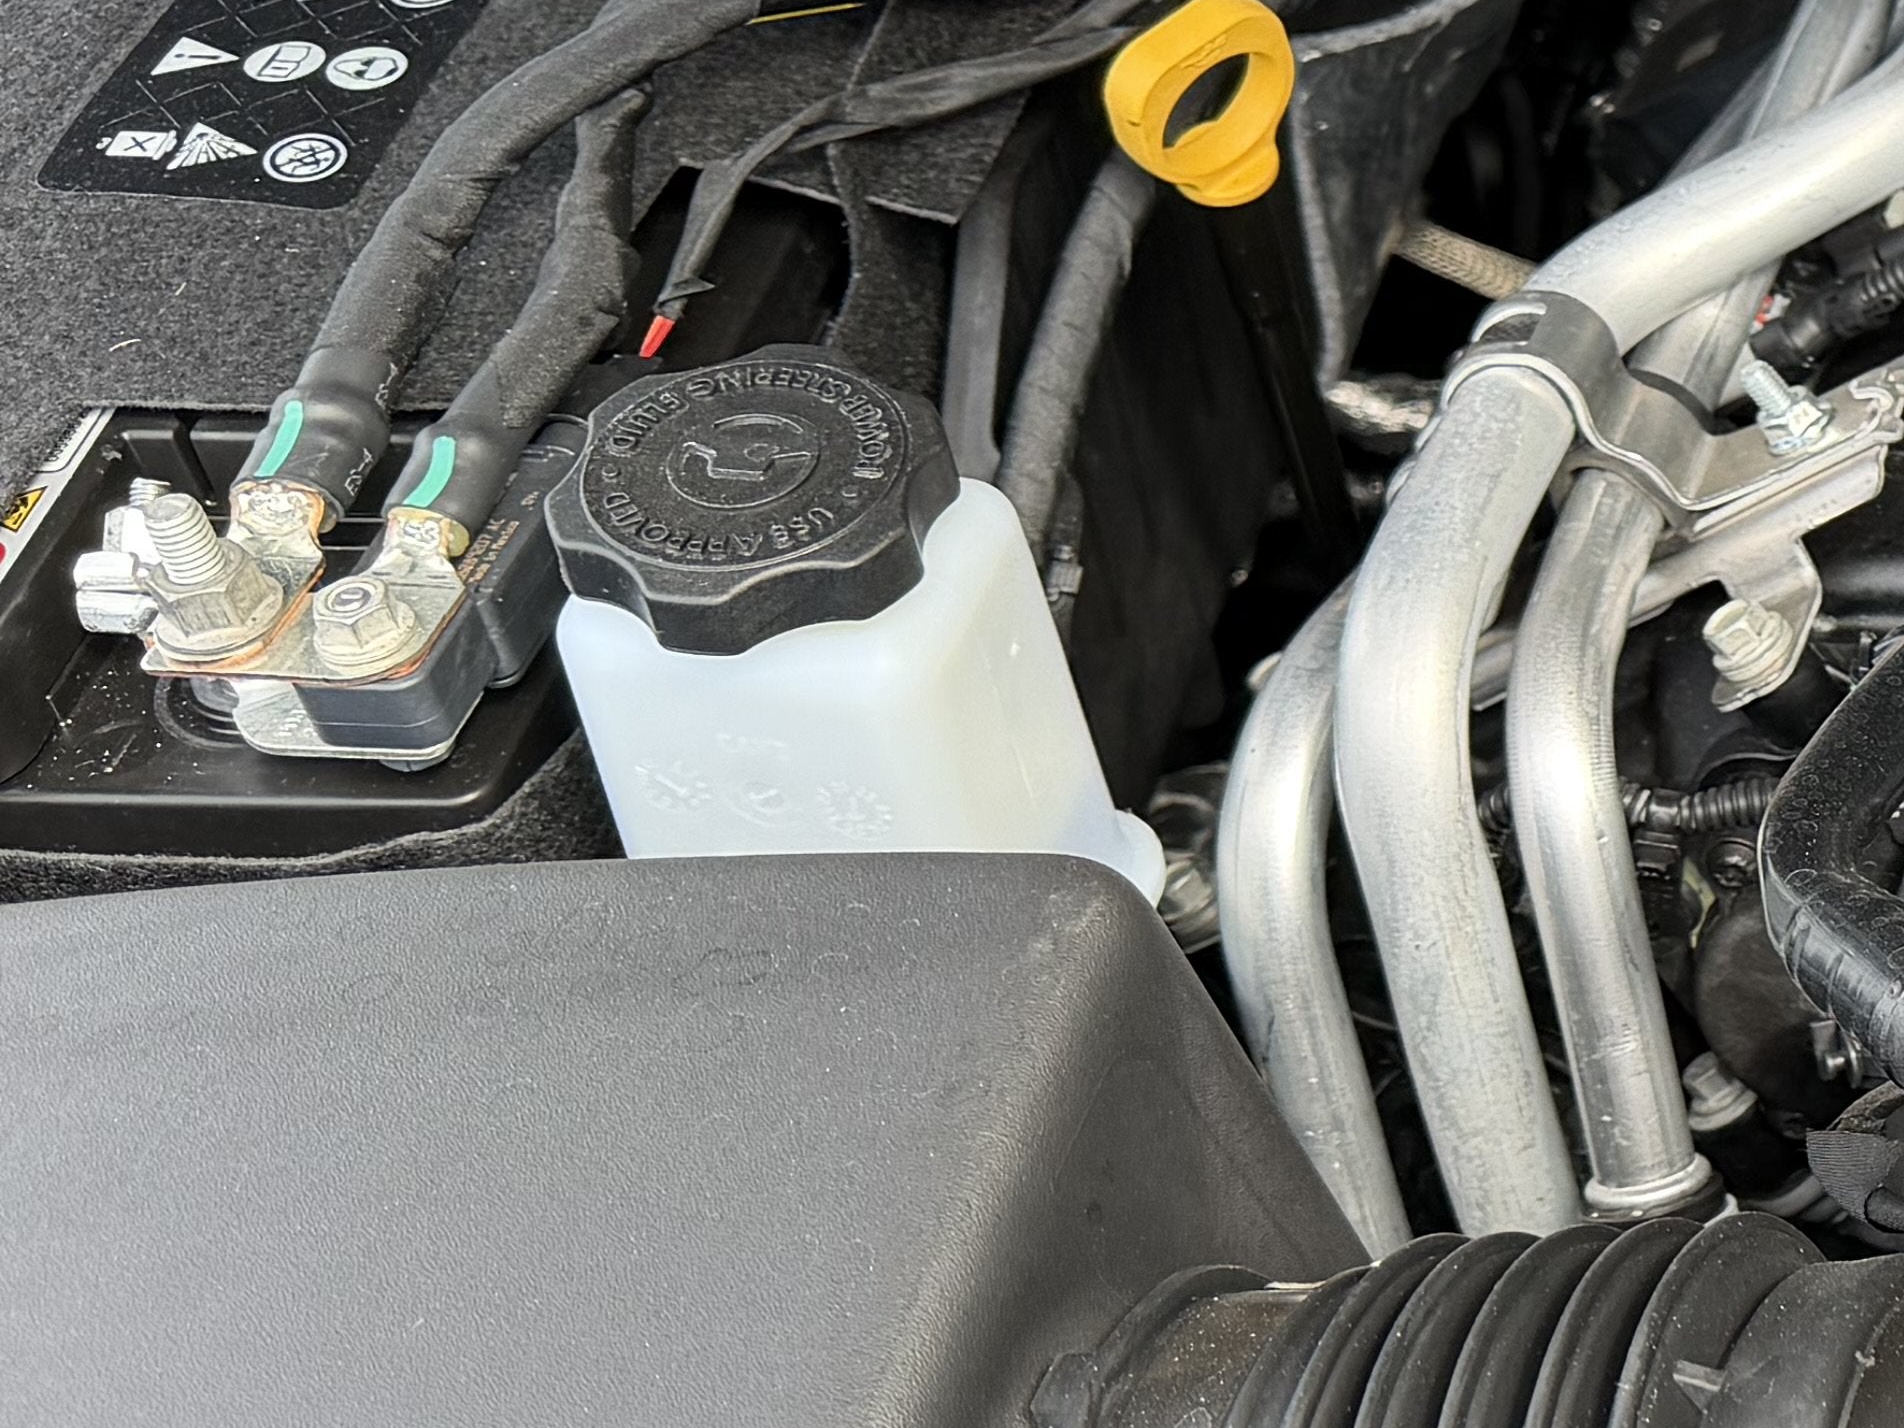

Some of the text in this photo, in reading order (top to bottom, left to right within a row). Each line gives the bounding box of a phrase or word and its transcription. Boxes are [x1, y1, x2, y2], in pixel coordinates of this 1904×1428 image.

[684, 367, 852, 403] STEERING
[605, 390, 690, 457] FLUID
[602, 491, 835, 560] USE APPROVED
